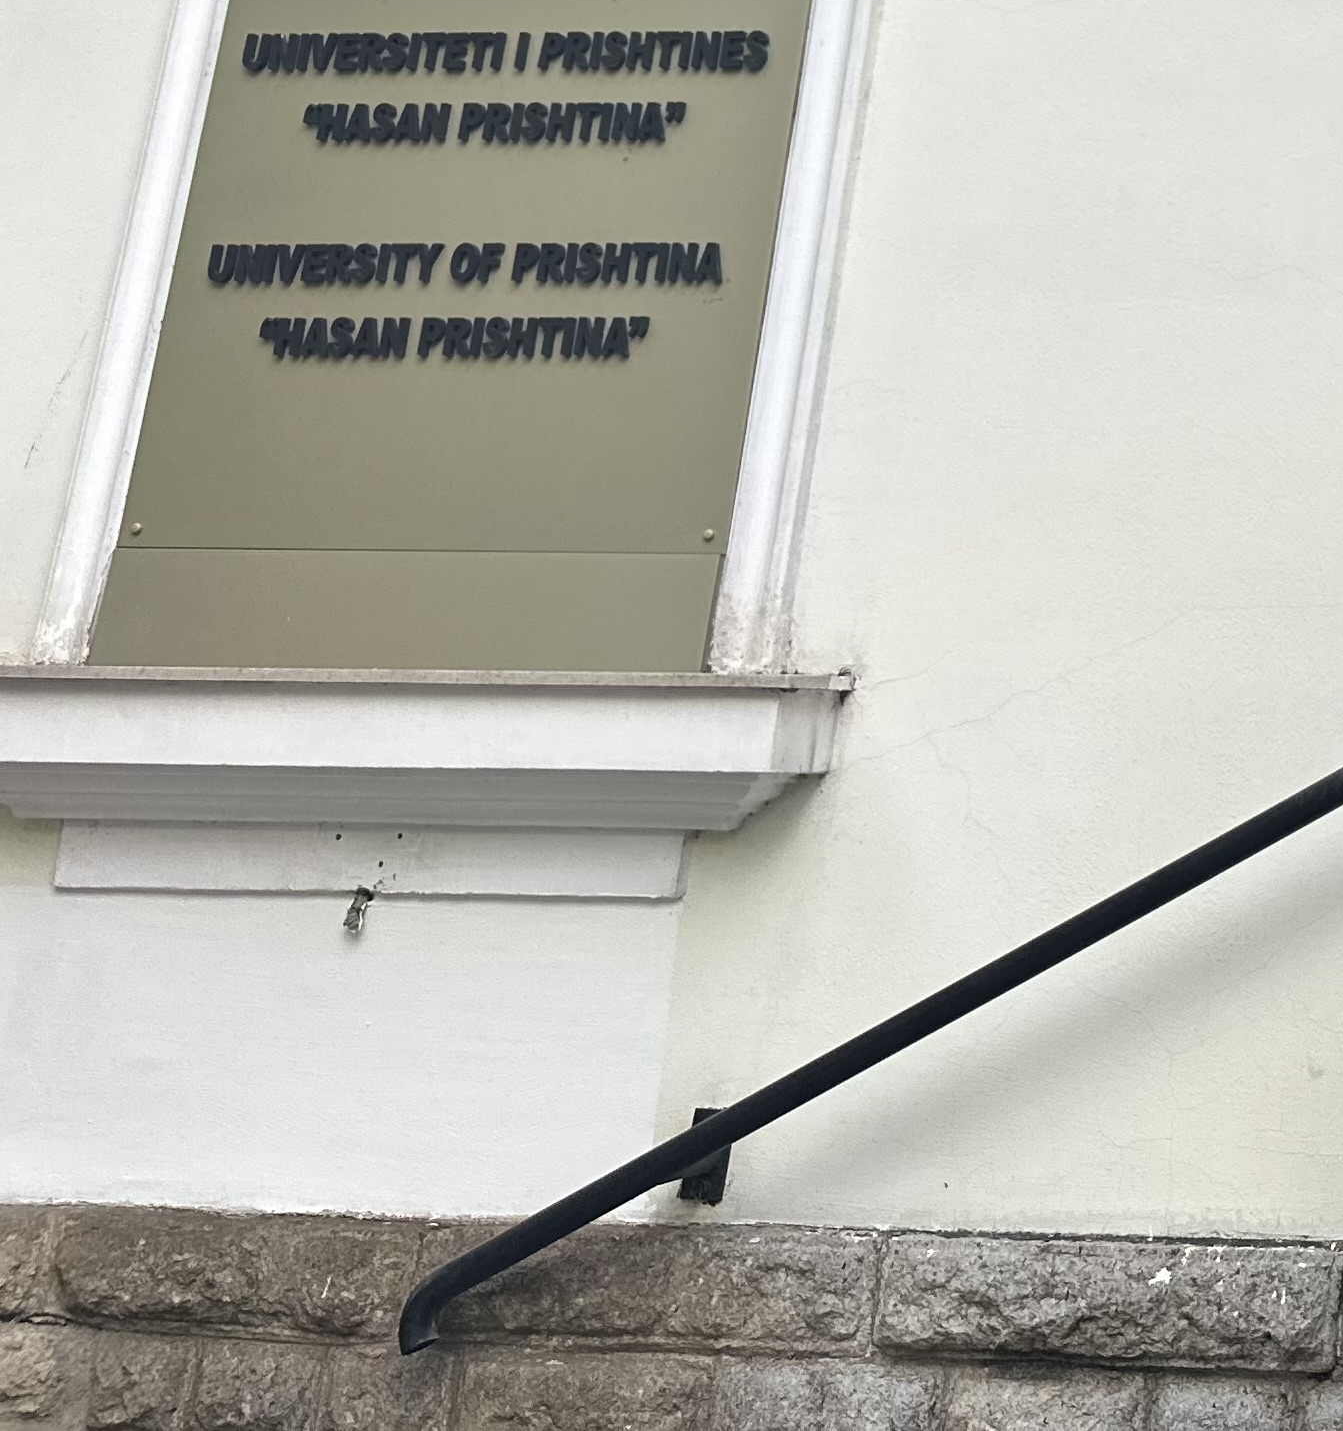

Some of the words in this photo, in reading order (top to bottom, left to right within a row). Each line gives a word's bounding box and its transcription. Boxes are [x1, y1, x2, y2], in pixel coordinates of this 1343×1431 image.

[242, 32, 508, 75] UNIVERSITETI
[514, 32, 531, 71] I
[537, 30, 771, 73] PRISHTINES
[207, 242, 446, 284] UNIVERSITY
[450, 242, 505, 285] OF
[511, 242, 724, 285] PRISHTINA
